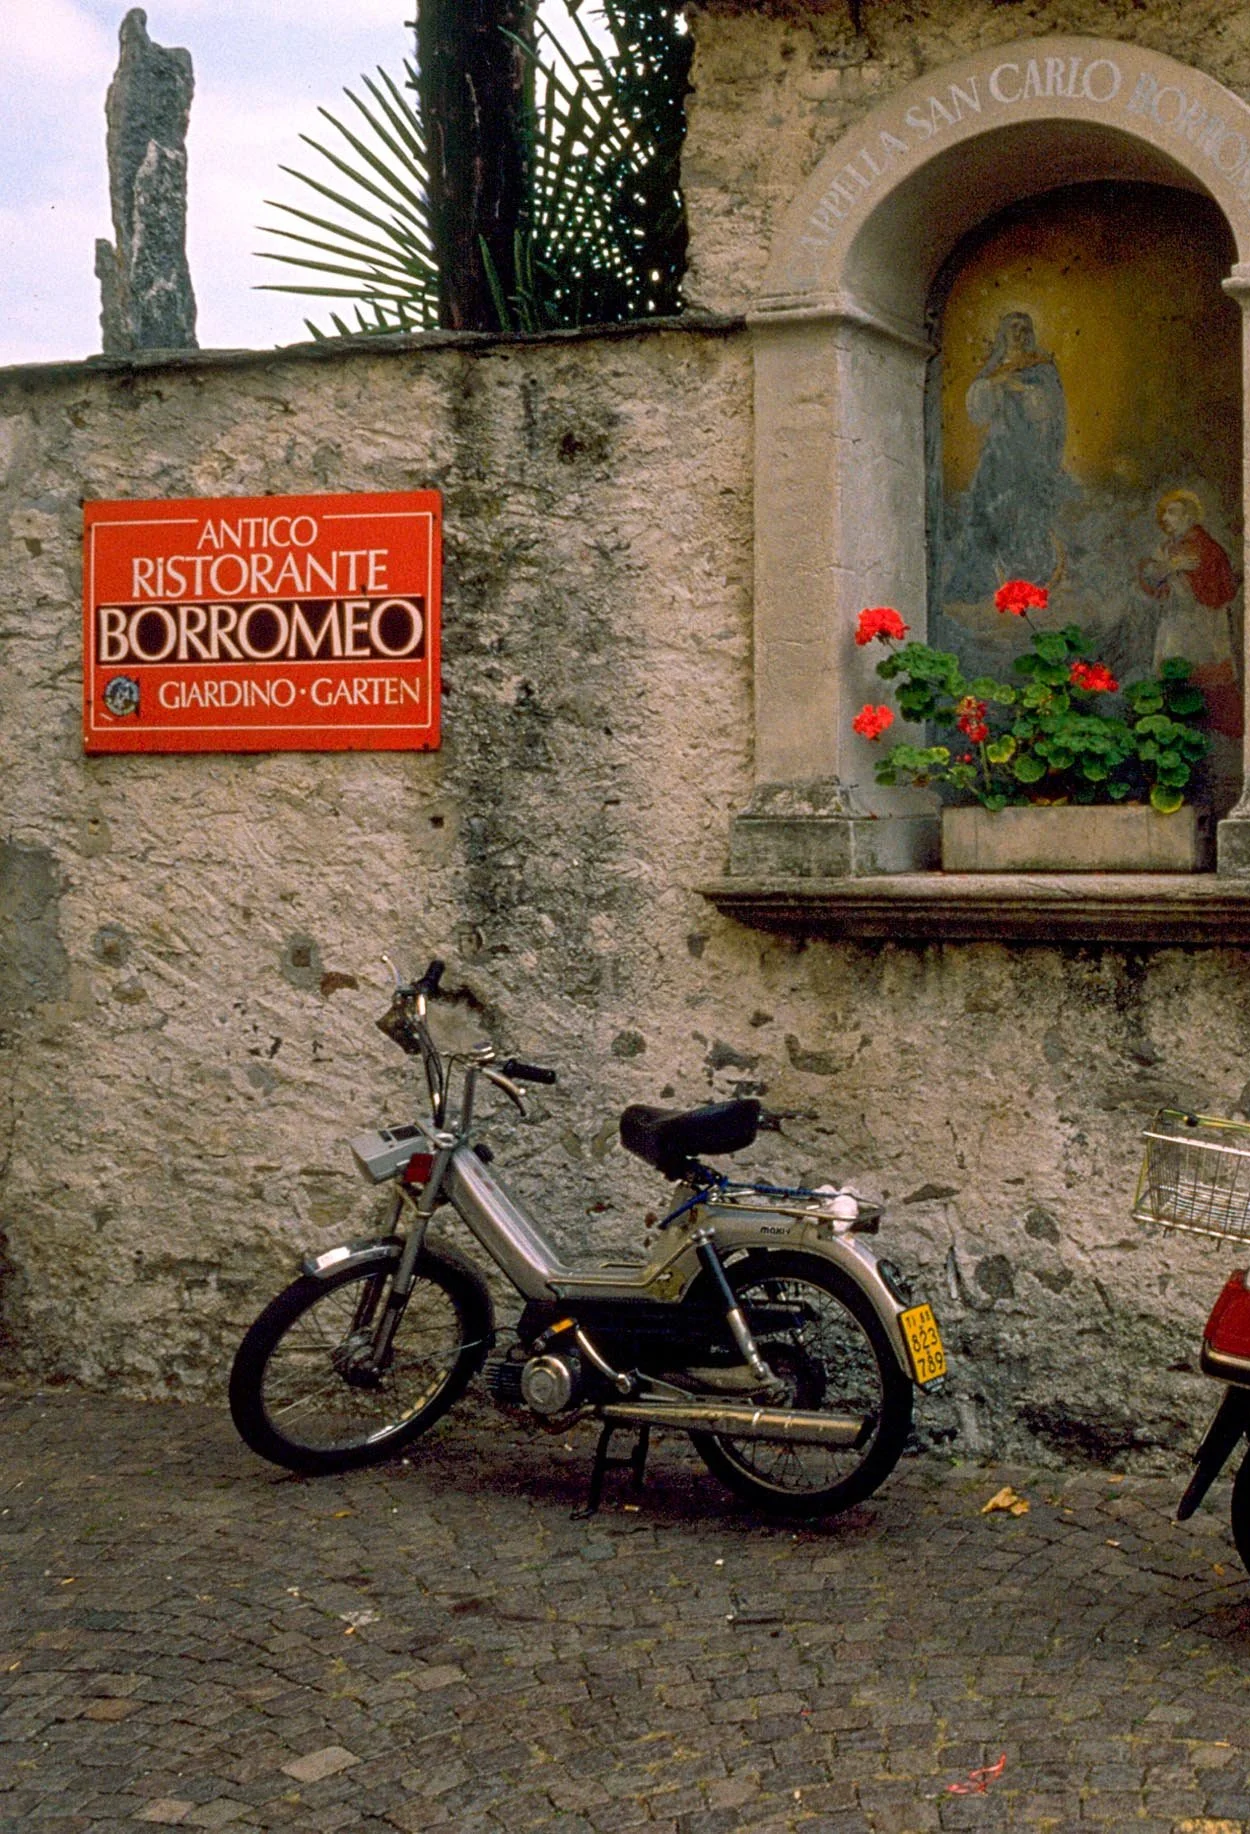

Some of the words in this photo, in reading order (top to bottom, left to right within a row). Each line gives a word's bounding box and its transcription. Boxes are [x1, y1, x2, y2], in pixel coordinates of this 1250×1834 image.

[904, 75, 982, 141] SAN
[989, 55, 1122, 104] CARLO
[197, 515, 318, 549] ANTICO
[131, 549, 389, 598] RISTORANTE
[99, 599, 424, 662] BORROMEO
[158, 678, 296, 709] GIARDINO
[310, 677, 420, 706] GARTEN
[911, 1327, 938, 1353] 823
[917, 1351, 943, 1378] 789
